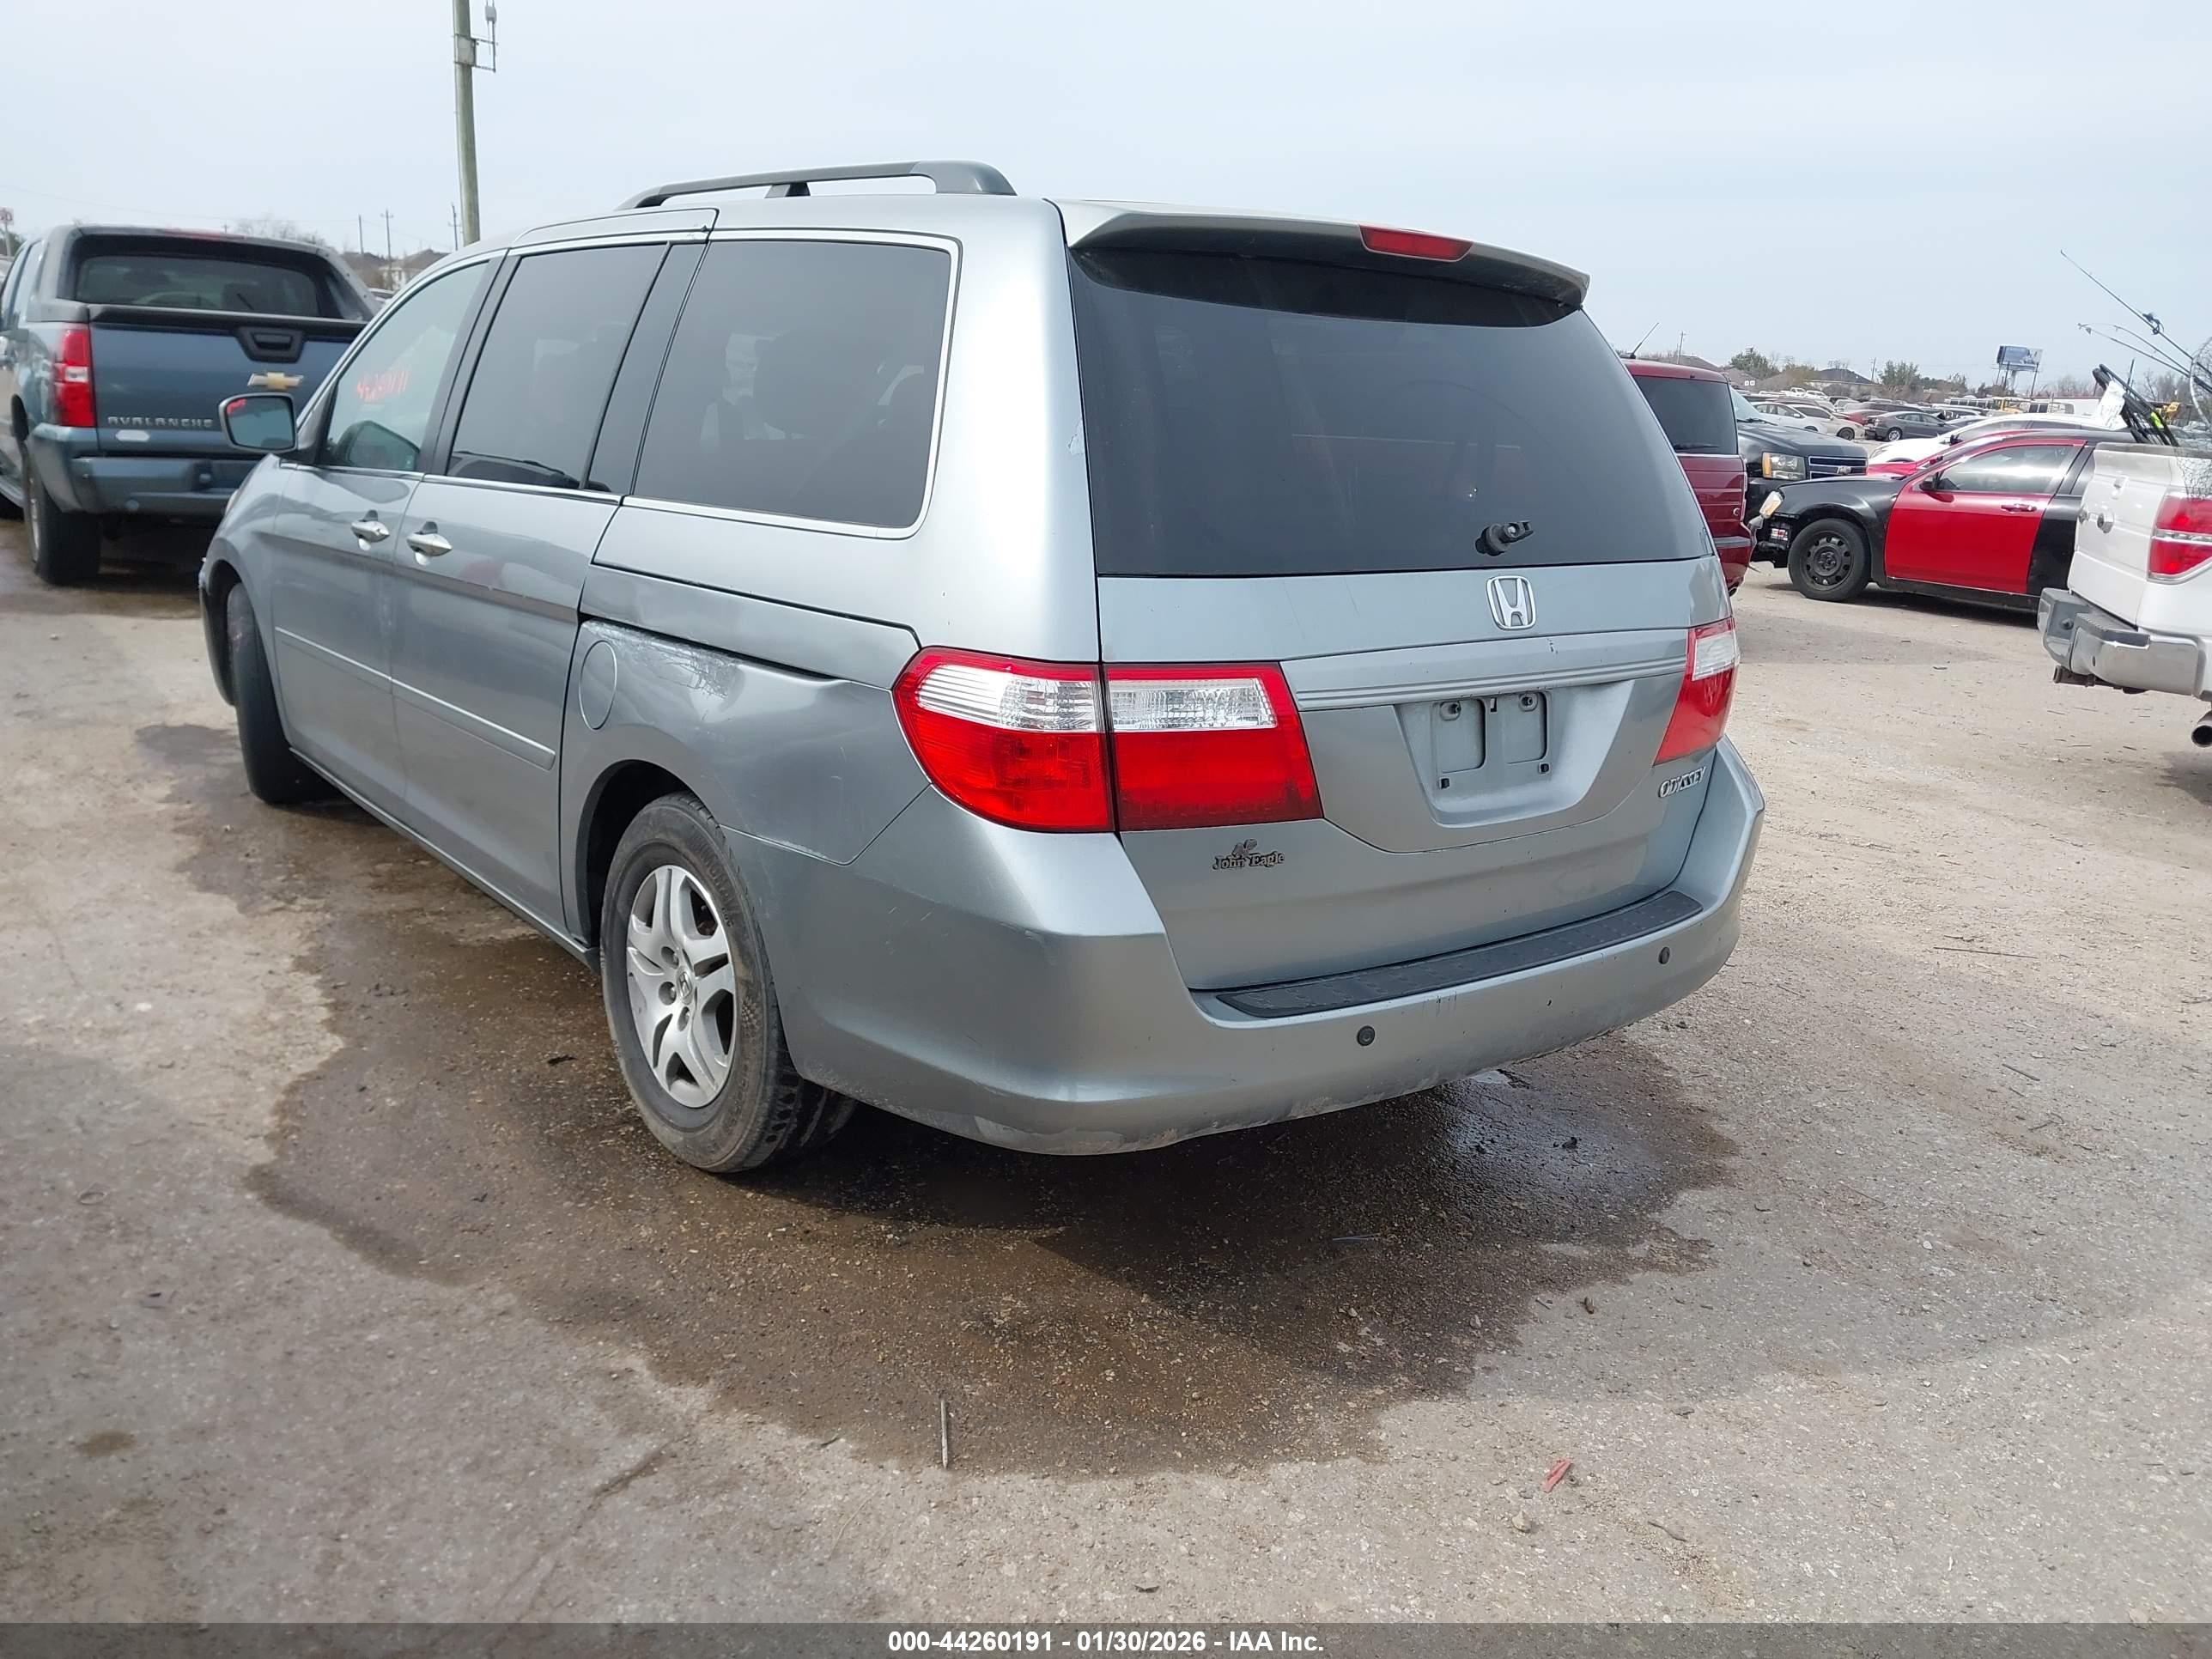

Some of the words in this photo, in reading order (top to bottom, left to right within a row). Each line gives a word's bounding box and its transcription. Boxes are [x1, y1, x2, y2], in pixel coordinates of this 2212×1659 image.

[107, 416, 214, 428] AVALANCHE
[1212, 855, 1245, 870] John
[1249, 851, 1285, 867] Eagle
